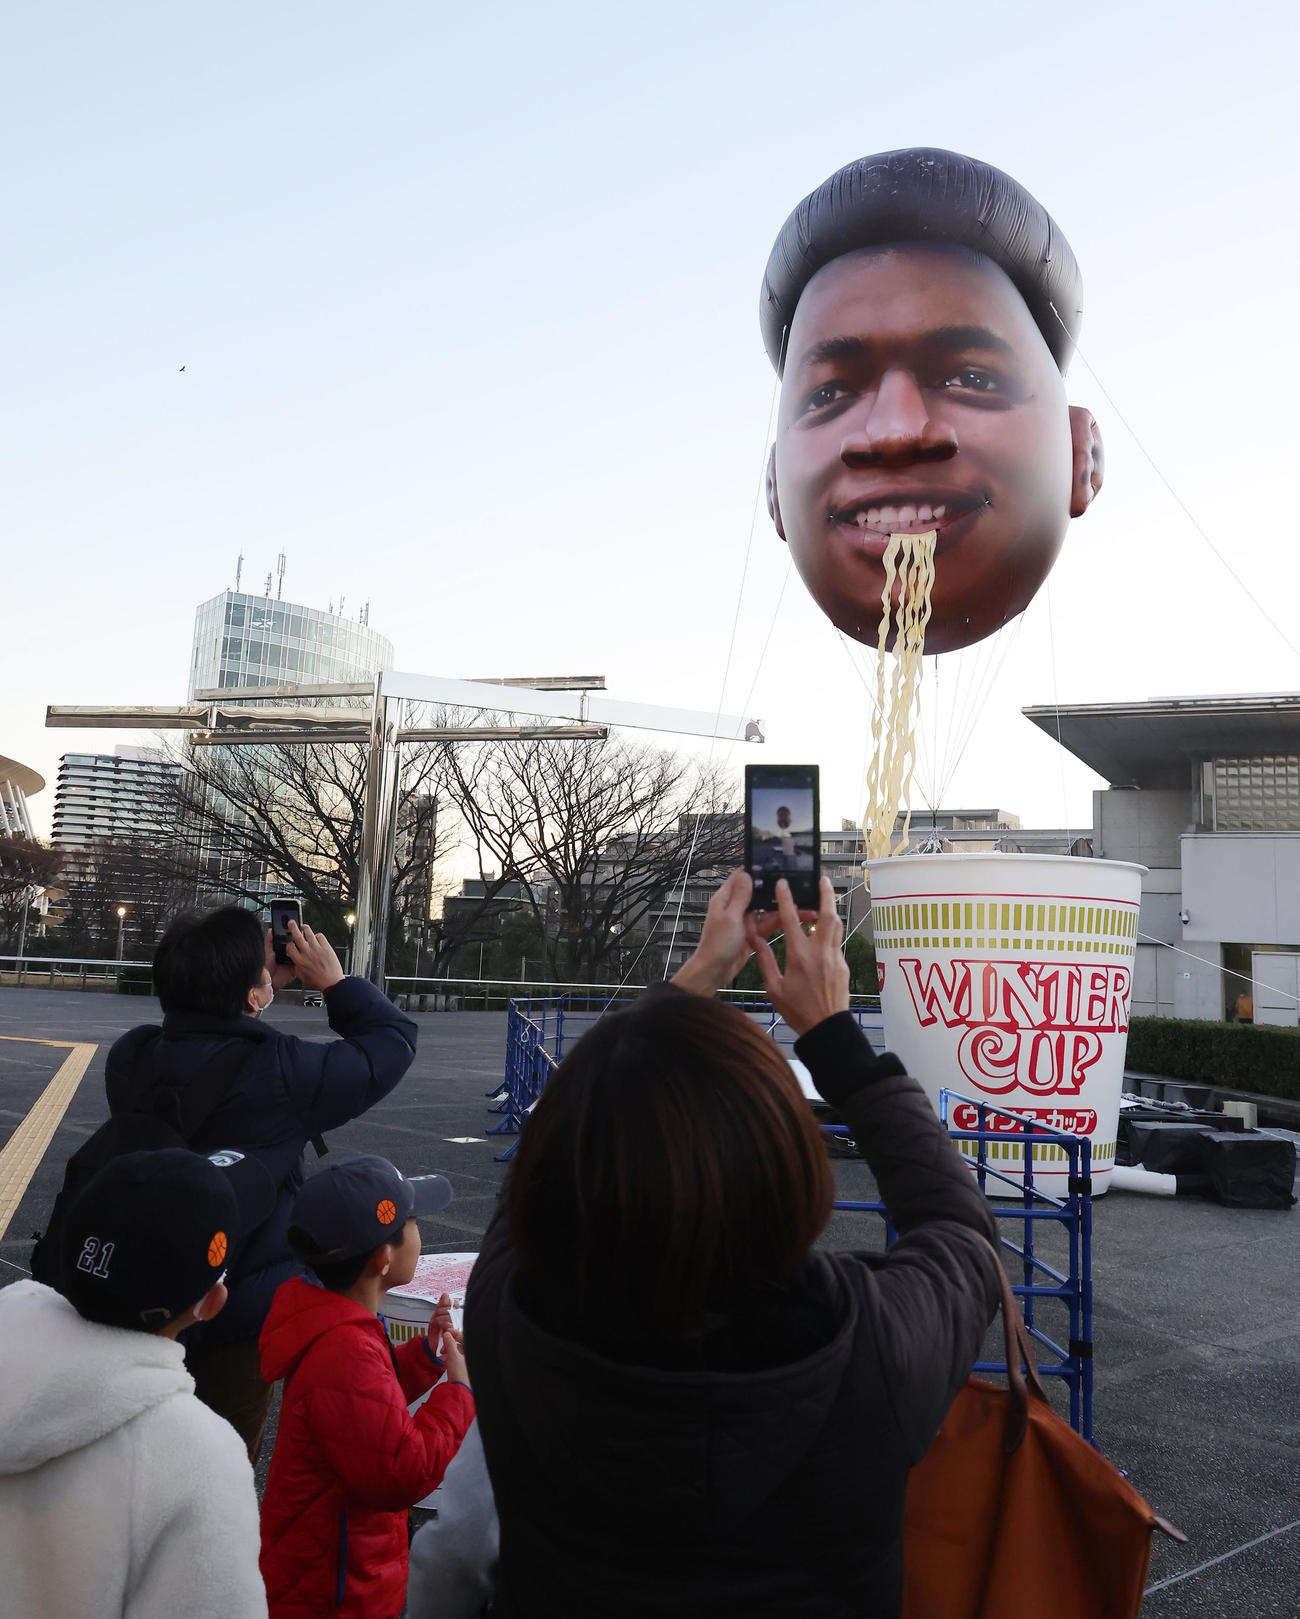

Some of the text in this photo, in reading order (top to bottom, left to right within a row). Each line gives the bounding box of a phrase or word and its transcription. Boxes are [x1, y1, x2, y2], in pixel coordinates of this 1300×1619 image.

[899, 958, 1131, 1033] WINTER
[957, 1025, 1103, 1096] CUP
[77, 1236, 115, 1279] 21
